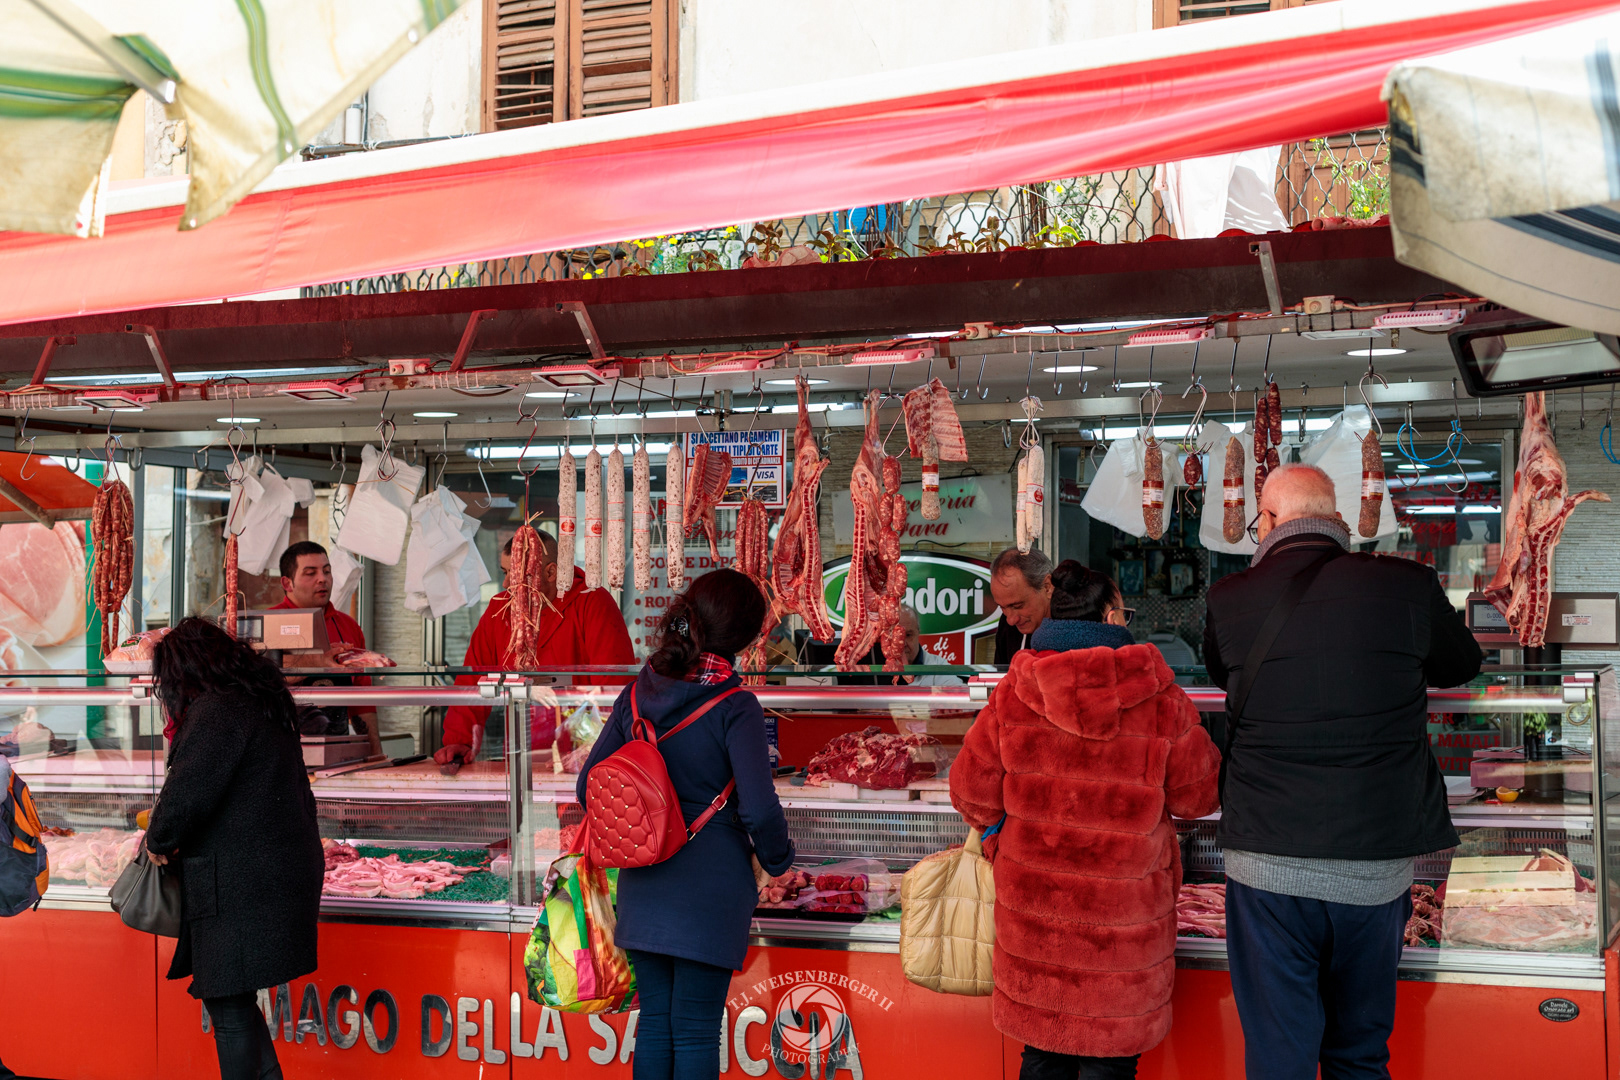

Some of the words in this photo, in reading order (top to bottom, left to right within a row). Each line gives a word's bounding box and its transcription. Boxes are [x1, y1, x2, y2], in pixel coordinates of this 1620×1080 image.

[691, 433, 698, 444] SI
[699, 432, 738, 444] ACCETTANO
[740, 430, 780, 443] PAGAMENTI
[756, 470, 775, 479] VISA
[421, 991, 569, 1065] DELLA
